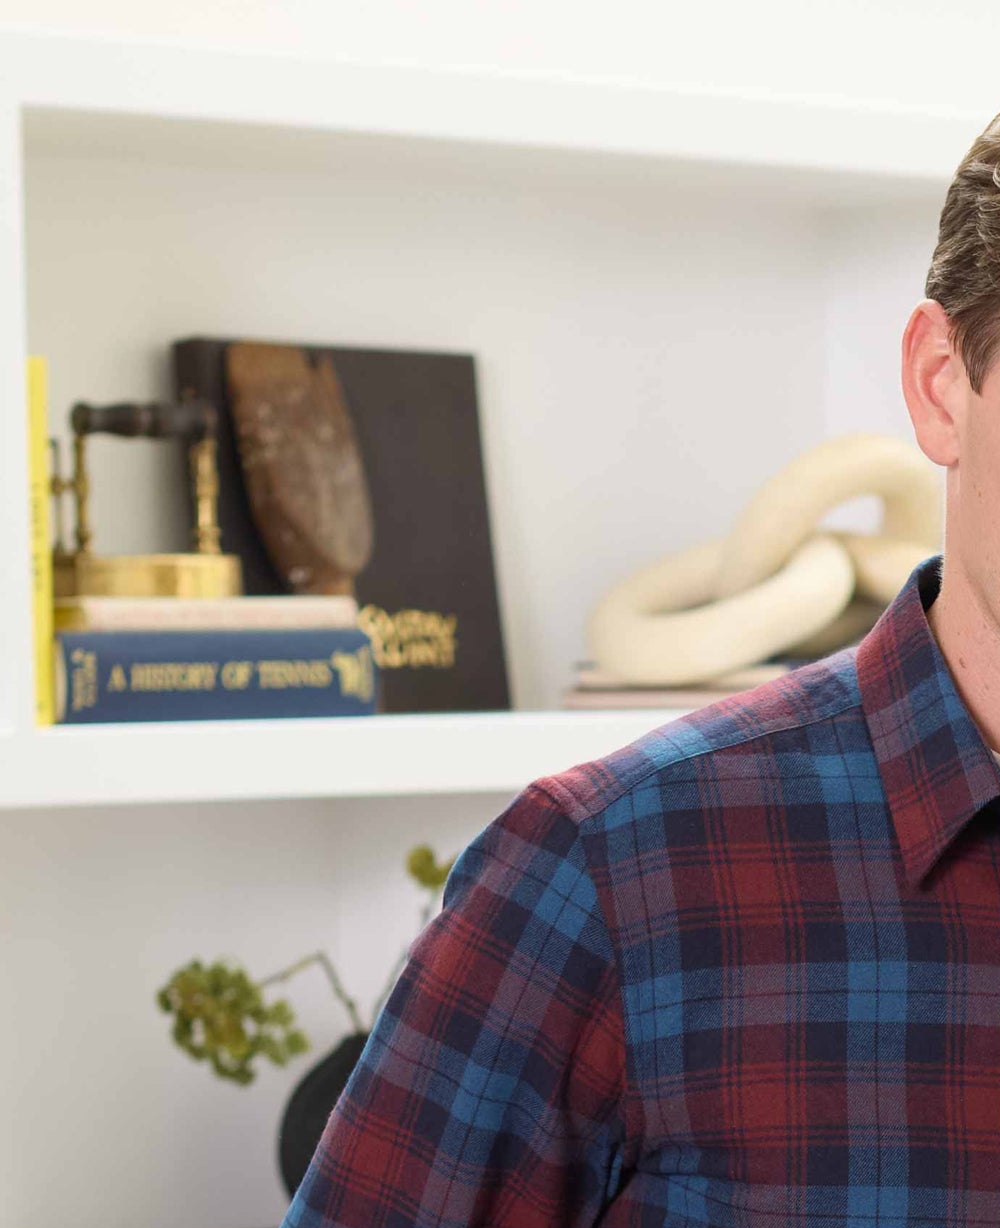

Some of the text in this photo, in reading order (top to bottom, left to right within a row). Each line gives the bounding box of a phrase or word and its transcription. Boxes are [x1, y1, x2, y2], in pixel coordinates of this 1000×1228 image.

[107, 664, 126, 692] A
[131, 662, 217, 691] HISTORY
[221, 661, 253, 690] OF
[258, 659, 332, 689] TENNIS
